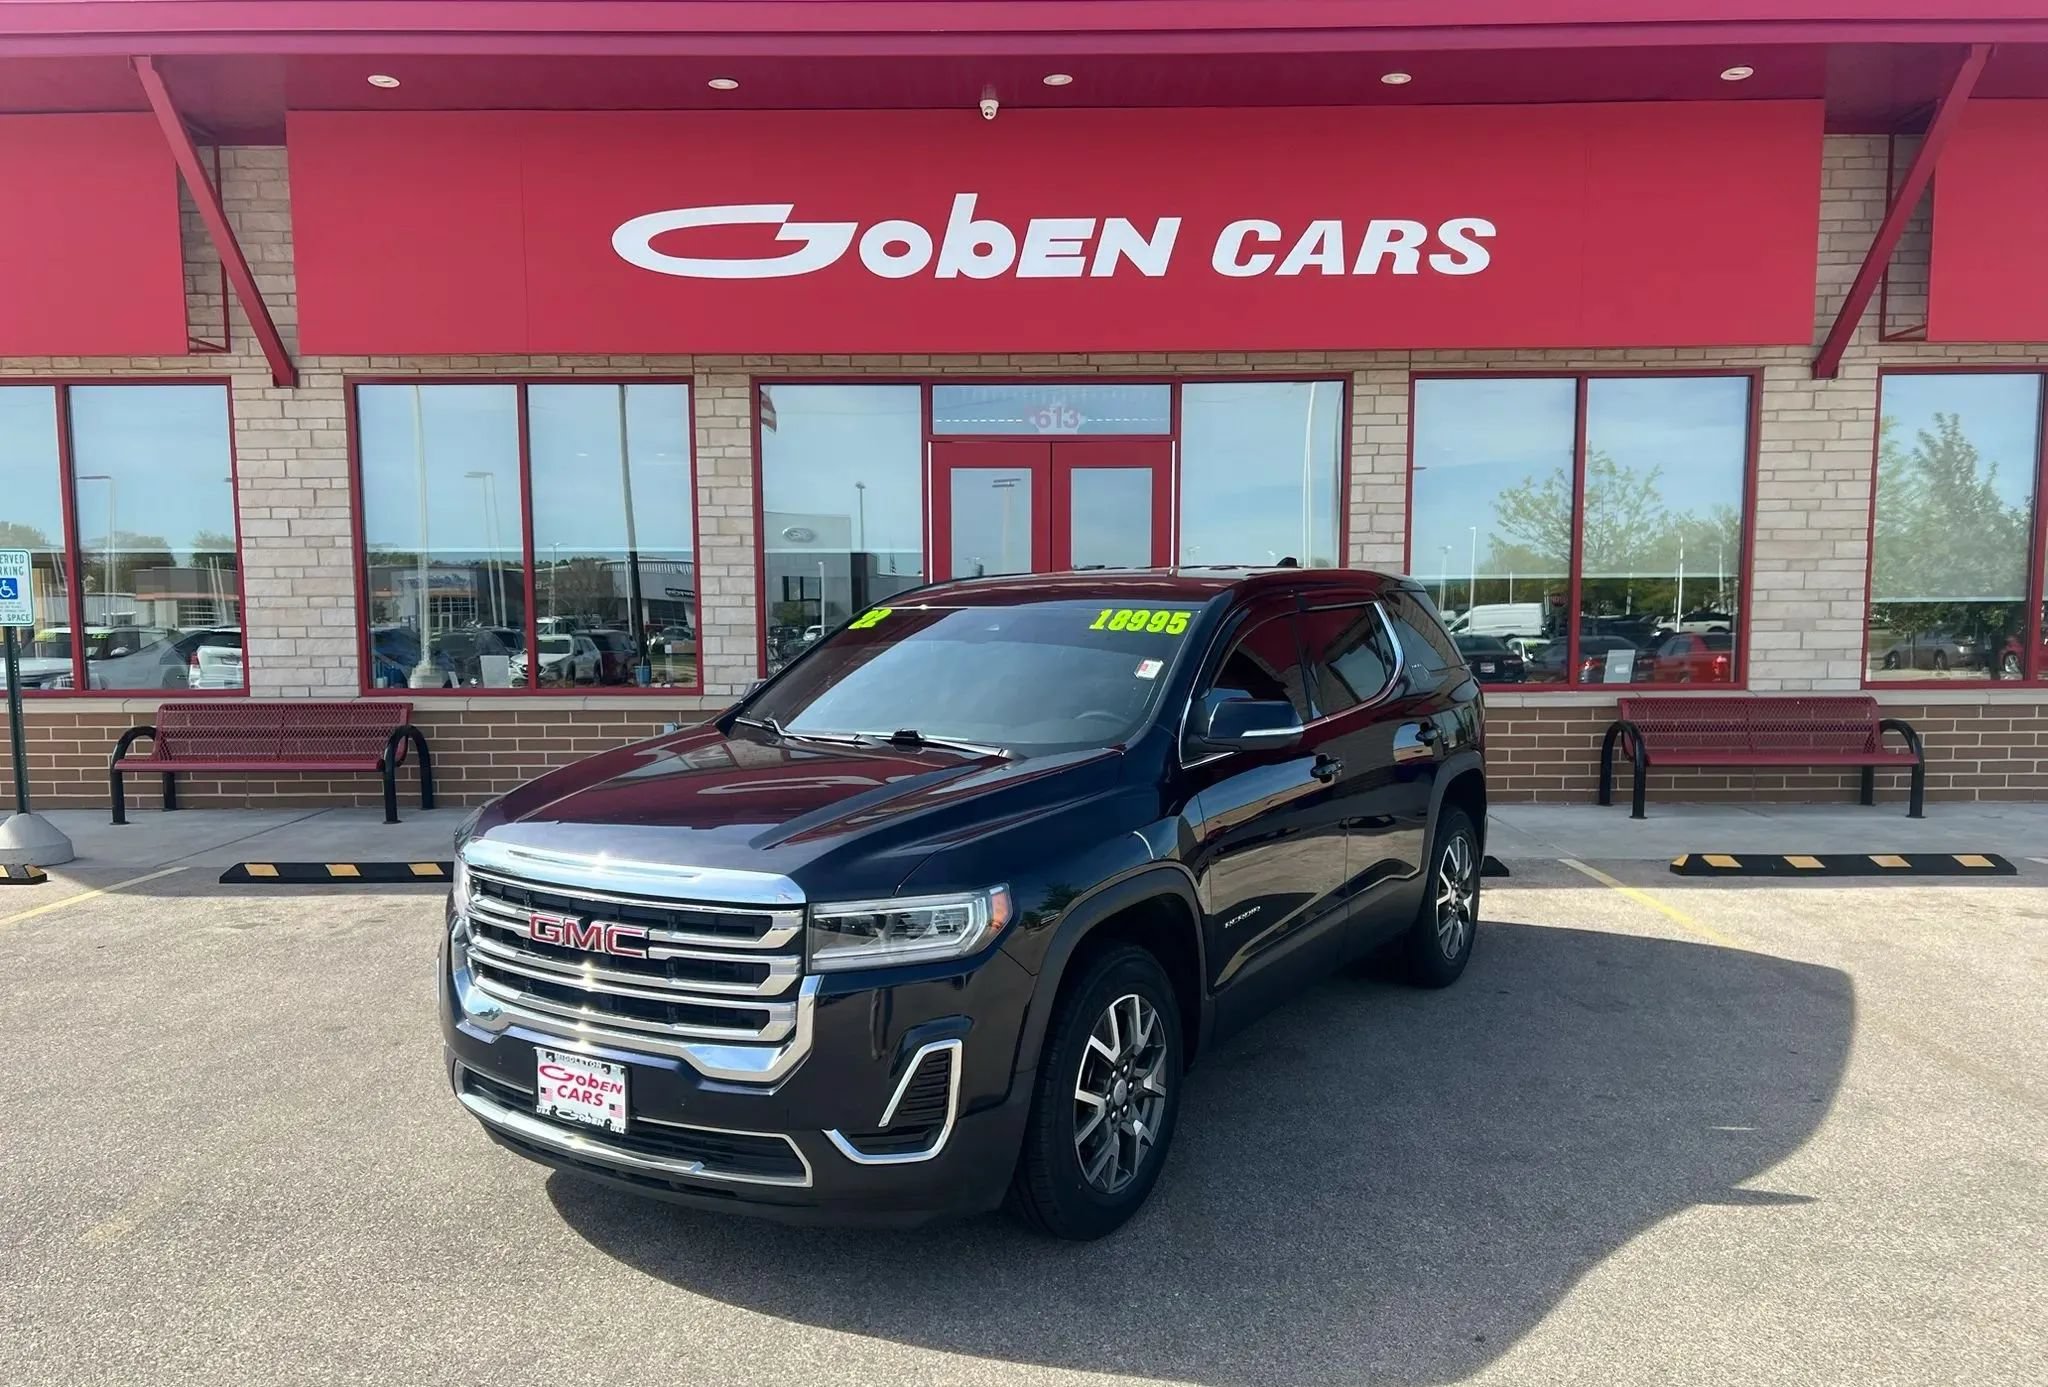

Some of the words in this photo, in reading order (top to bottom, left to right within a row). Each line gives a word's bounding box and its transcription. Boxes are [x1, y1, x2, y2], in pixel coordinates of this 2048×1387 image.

[1211, 218, 1497, 277] CARS
[1034, 406, 1079, 429] 613
[7, 614, 30, 622] SPACE
[1089, 608, 1192, 635] 18995
[529, 912, 649, 960] GMC
[558, 1085, 604, 1106] CARS
